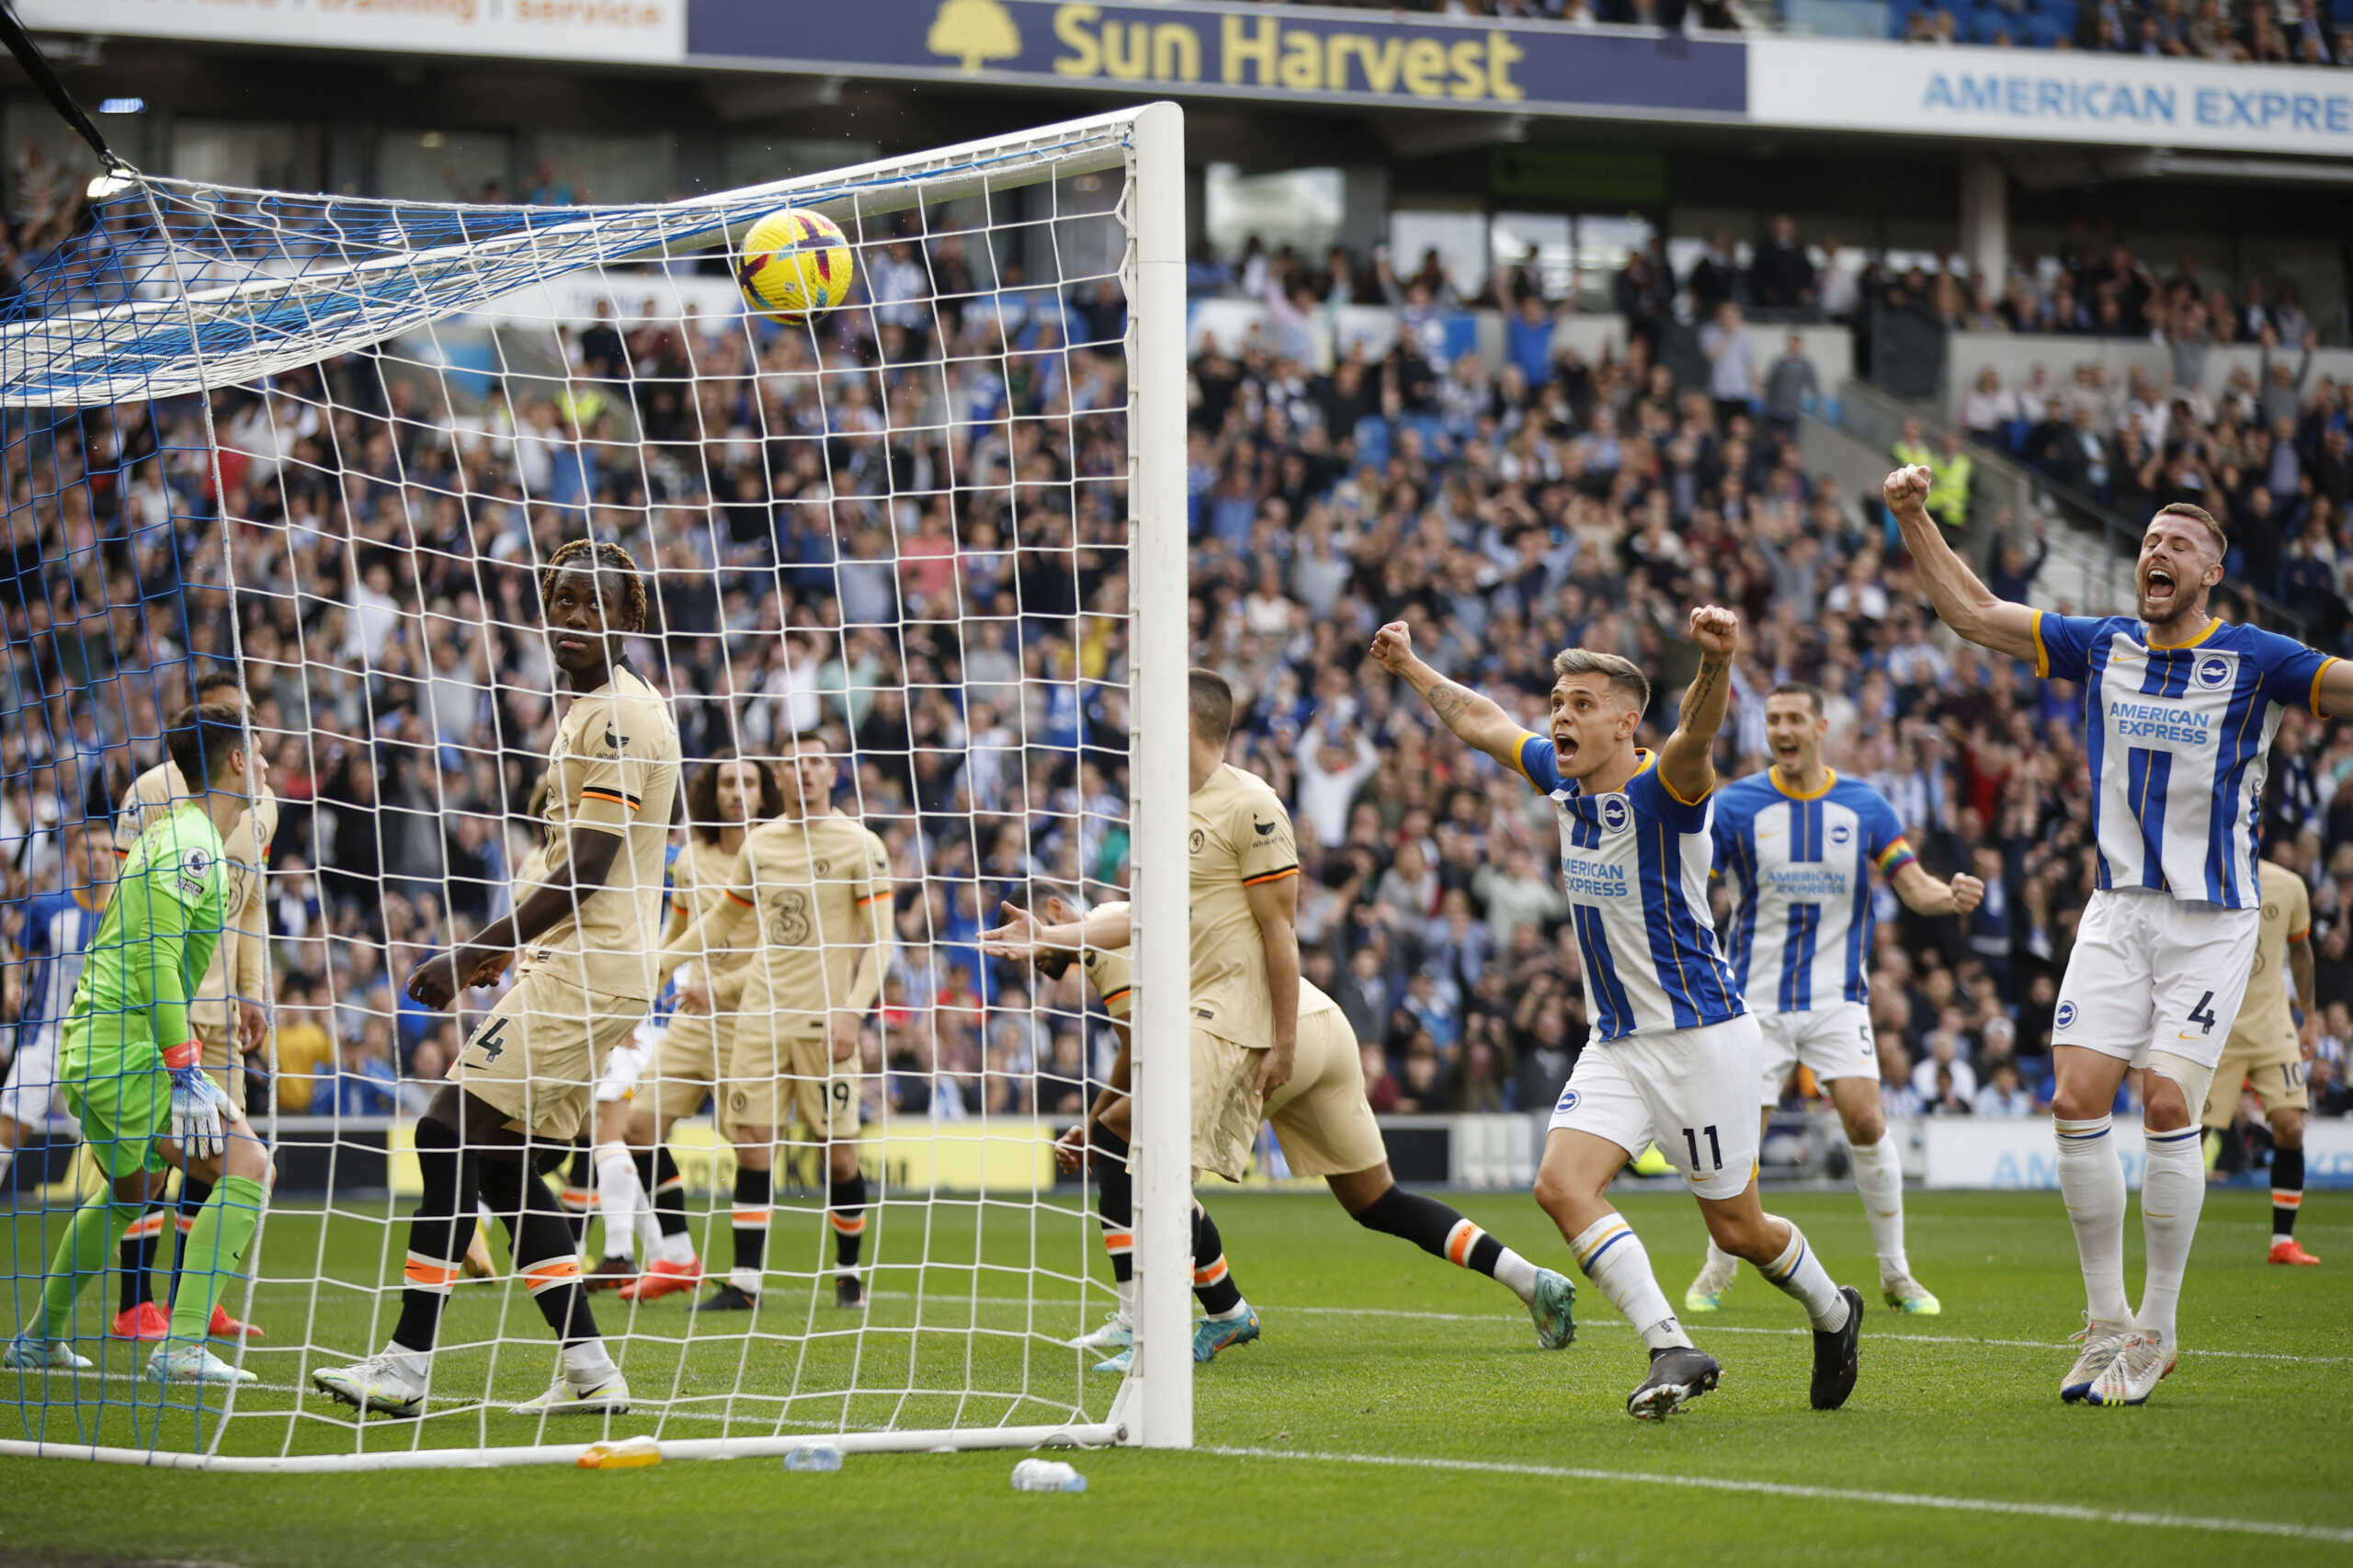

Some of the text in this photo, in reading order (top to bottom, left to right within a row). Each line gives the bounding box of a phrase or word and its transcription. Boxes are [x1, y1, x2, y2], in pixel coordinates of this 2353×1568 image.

[1052, 2, 1525, 100] Sun Harvest
[1923, 74, 2174, 122] AMERICAN
[2109, 701, 2210, 728] AMERICAN
[2118, 720, 2208, 745] EXPRESS
[1767, 870, 1846, 883] AMERICAN
[2187, 990, 2216, 1035] 4
[465, 1017, 508, 1063] 4
[1859, 1024, 1873, 1056] 5
[2279, 1061, 2306, 1088] 10
[817, 1081, 849, 1113] 19
[1682, 1124, 1722, 1171] 11
